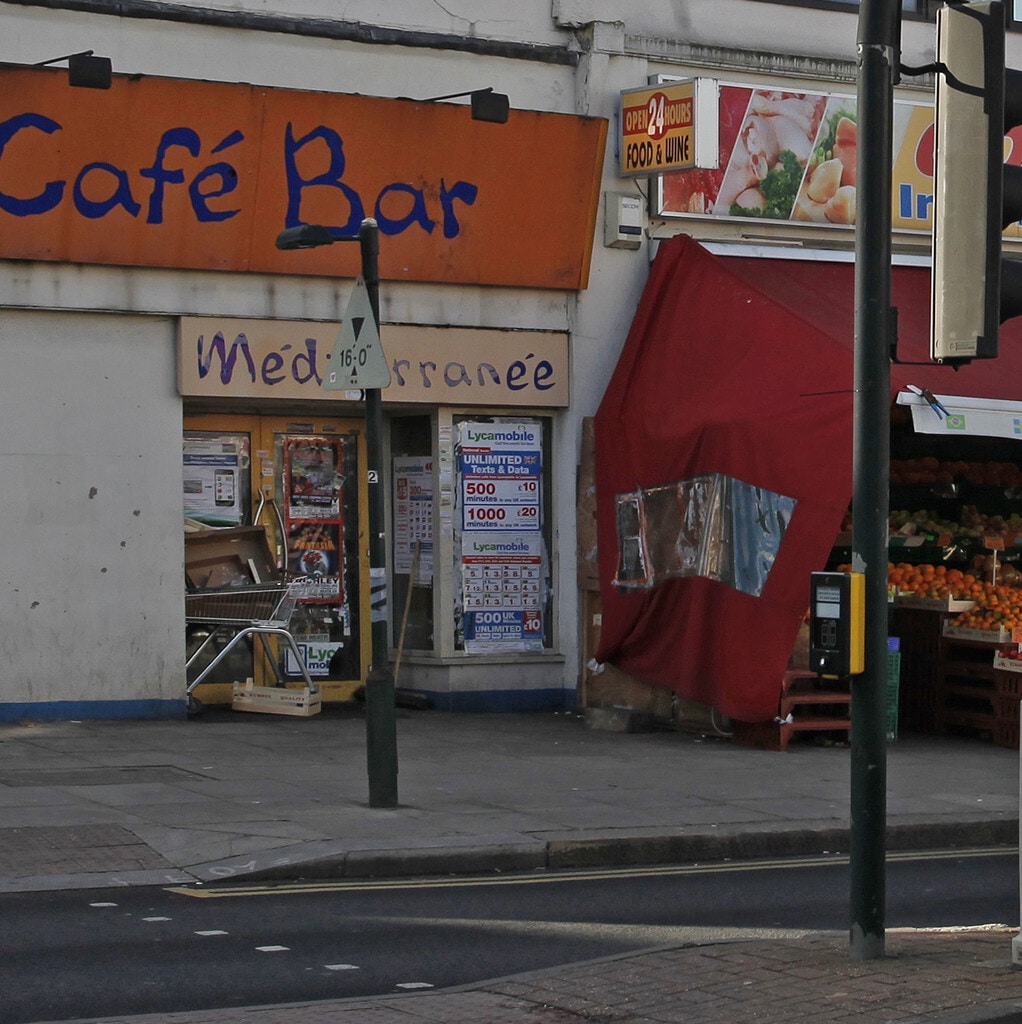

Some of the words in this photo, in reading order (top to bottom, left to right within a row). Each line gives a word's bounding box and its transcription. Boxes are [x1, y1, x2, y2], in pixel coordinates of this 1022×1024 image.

[626, 108, 649, 132] OPEN
[647, 95, 665, 136] 24
[664, 102, 692, 126] HOURS
[626, 140, 653, 169] FOOD
[656, 144, 662, 164] &
[665, 134, 689, 164] WINE
[0, 112, 245, 225] Café
[284, 121, 478, 240] Bar
[467, 429, 535, 442] Lycamobile
[464, 455, 522, 465] UNLIMITED
[471, 465, 496, 474] Texts
[498, 465, 505, 474] &
[507, 465, 530, 474] Data
[368, 471, 376, 482] 2
[466, 482, 496, 495] 500
[468, 508, 506, 521] 1000
[473, 542, 530, 553] Lycamobile
[474, 612, 502, 625] 500
[523, 619, 541, 631] £10
[474, 625, 522, 633] UNLIMITED
